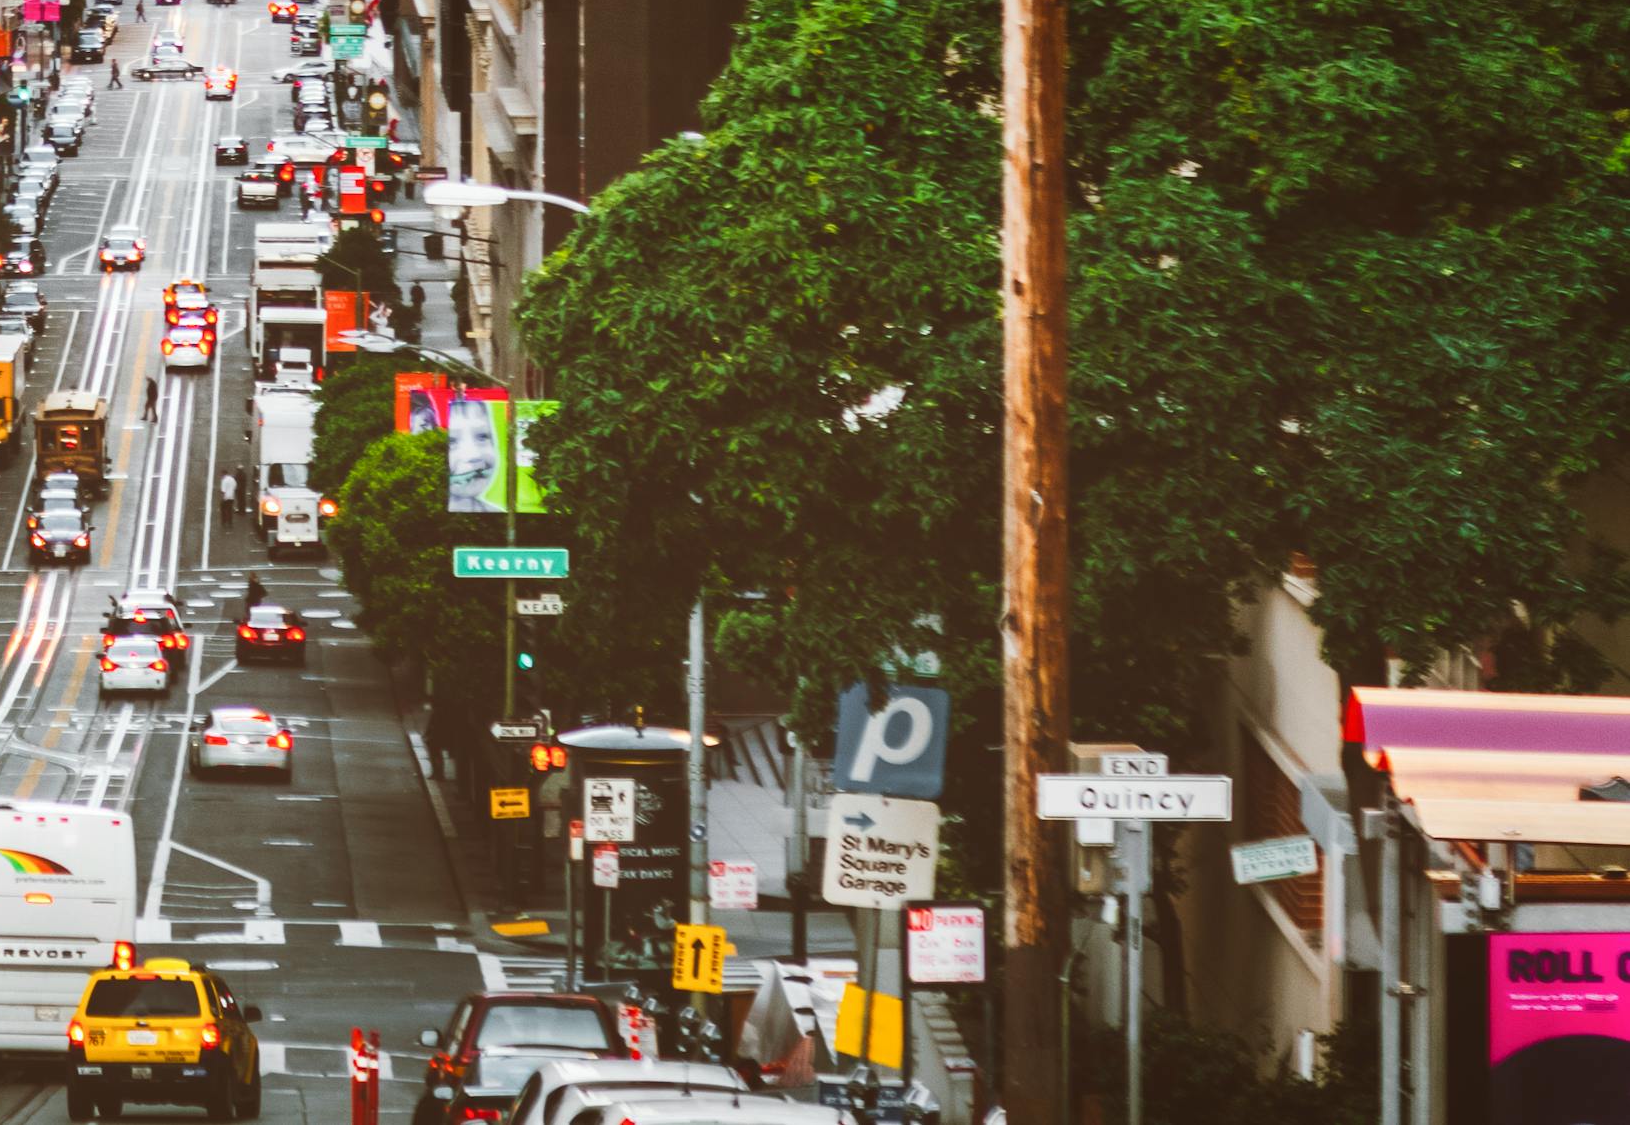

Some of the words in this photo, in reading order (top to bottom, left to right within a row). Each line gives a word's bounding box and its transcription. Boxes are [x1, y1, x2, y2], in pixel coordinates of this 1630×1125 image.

[466, 555, 555, 575] Kearny
[1111, 760, 1160, 775] END
[1079, 787, 1195, 817] Quincy
[841, 834, 862, 851] St
[866, 836, 931, 860] Mary's
[839, 853, 908, 875] Square
[838, 873, 908, 897] Garage
[1508, 949, 1604, 983] ROLL
